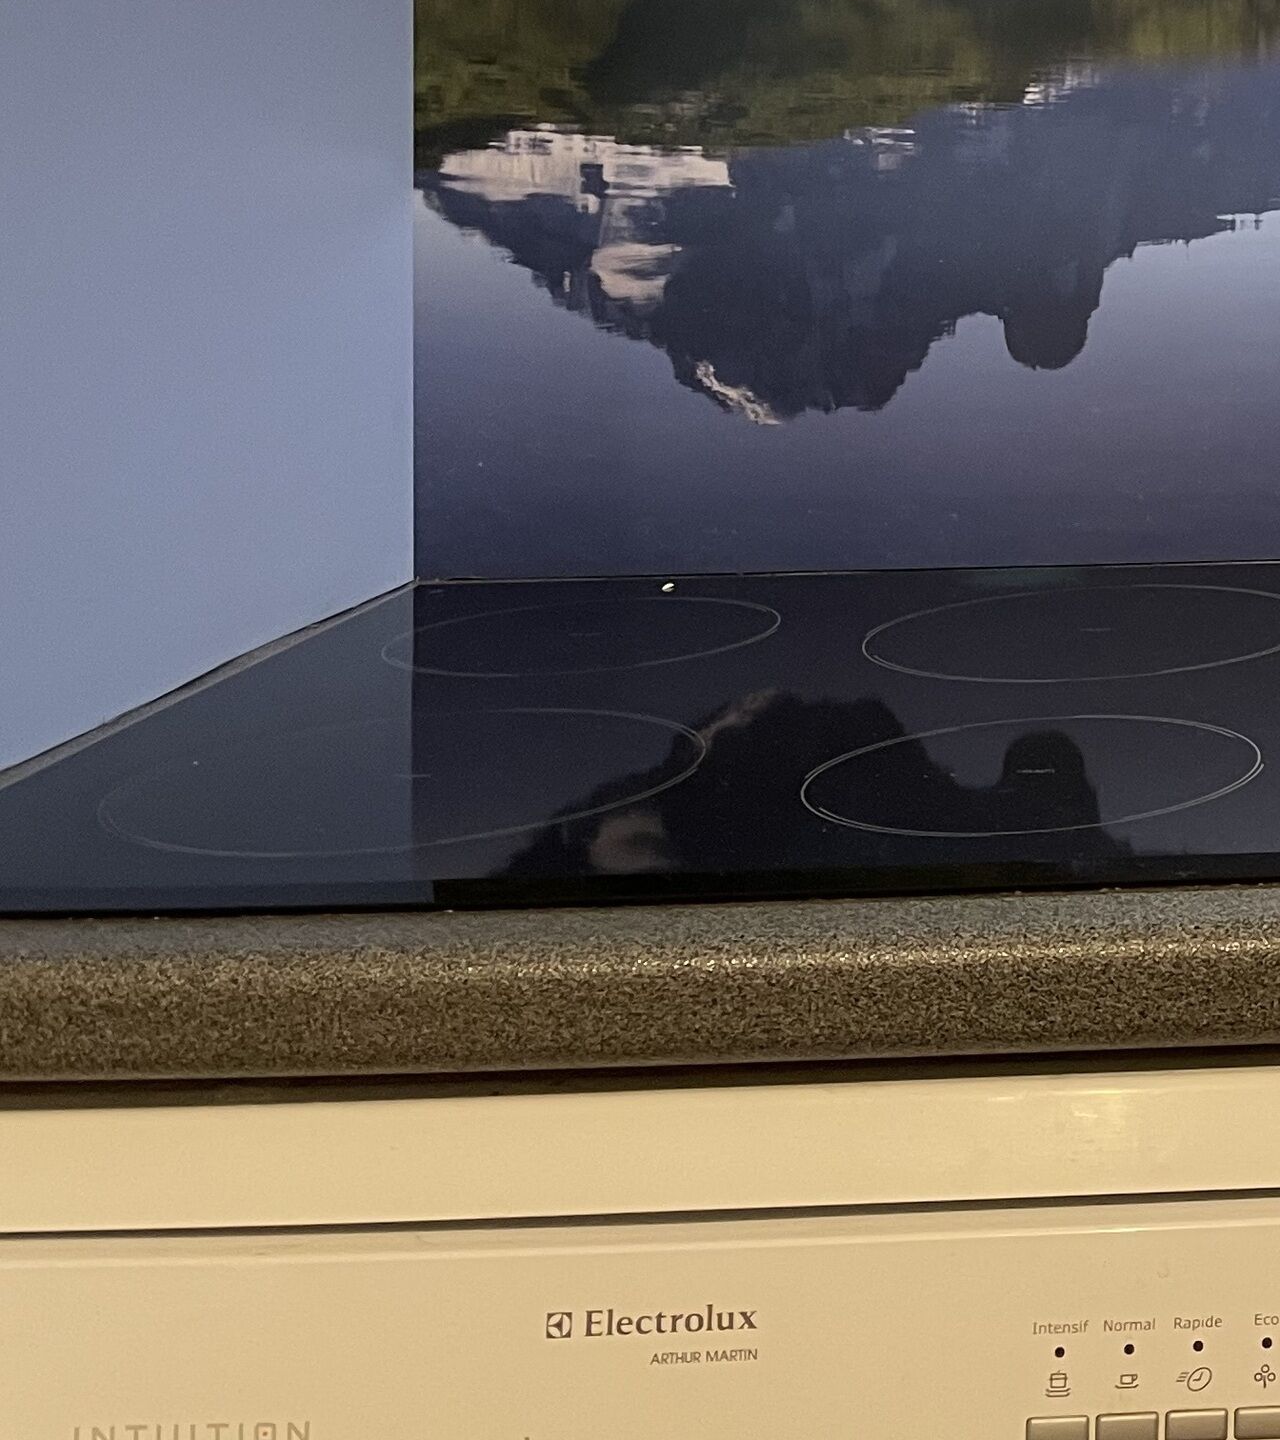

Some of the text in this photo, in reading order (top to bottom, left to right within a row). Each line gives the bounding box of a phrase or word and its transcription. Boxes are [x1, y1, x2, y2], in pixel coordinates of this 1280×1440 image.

[584, 1304, 758, 1337] Electrolux
[1103, 1318, 1156, 1333] Normal
[1173, 1315, 1223, 1331] Rapide
[1254, 1313, 1280, 1326] Eco
[1032, 1320, 1090, 1336] Intensif
[649, 1348, 758, 1366] ARTHUR MARTIN
